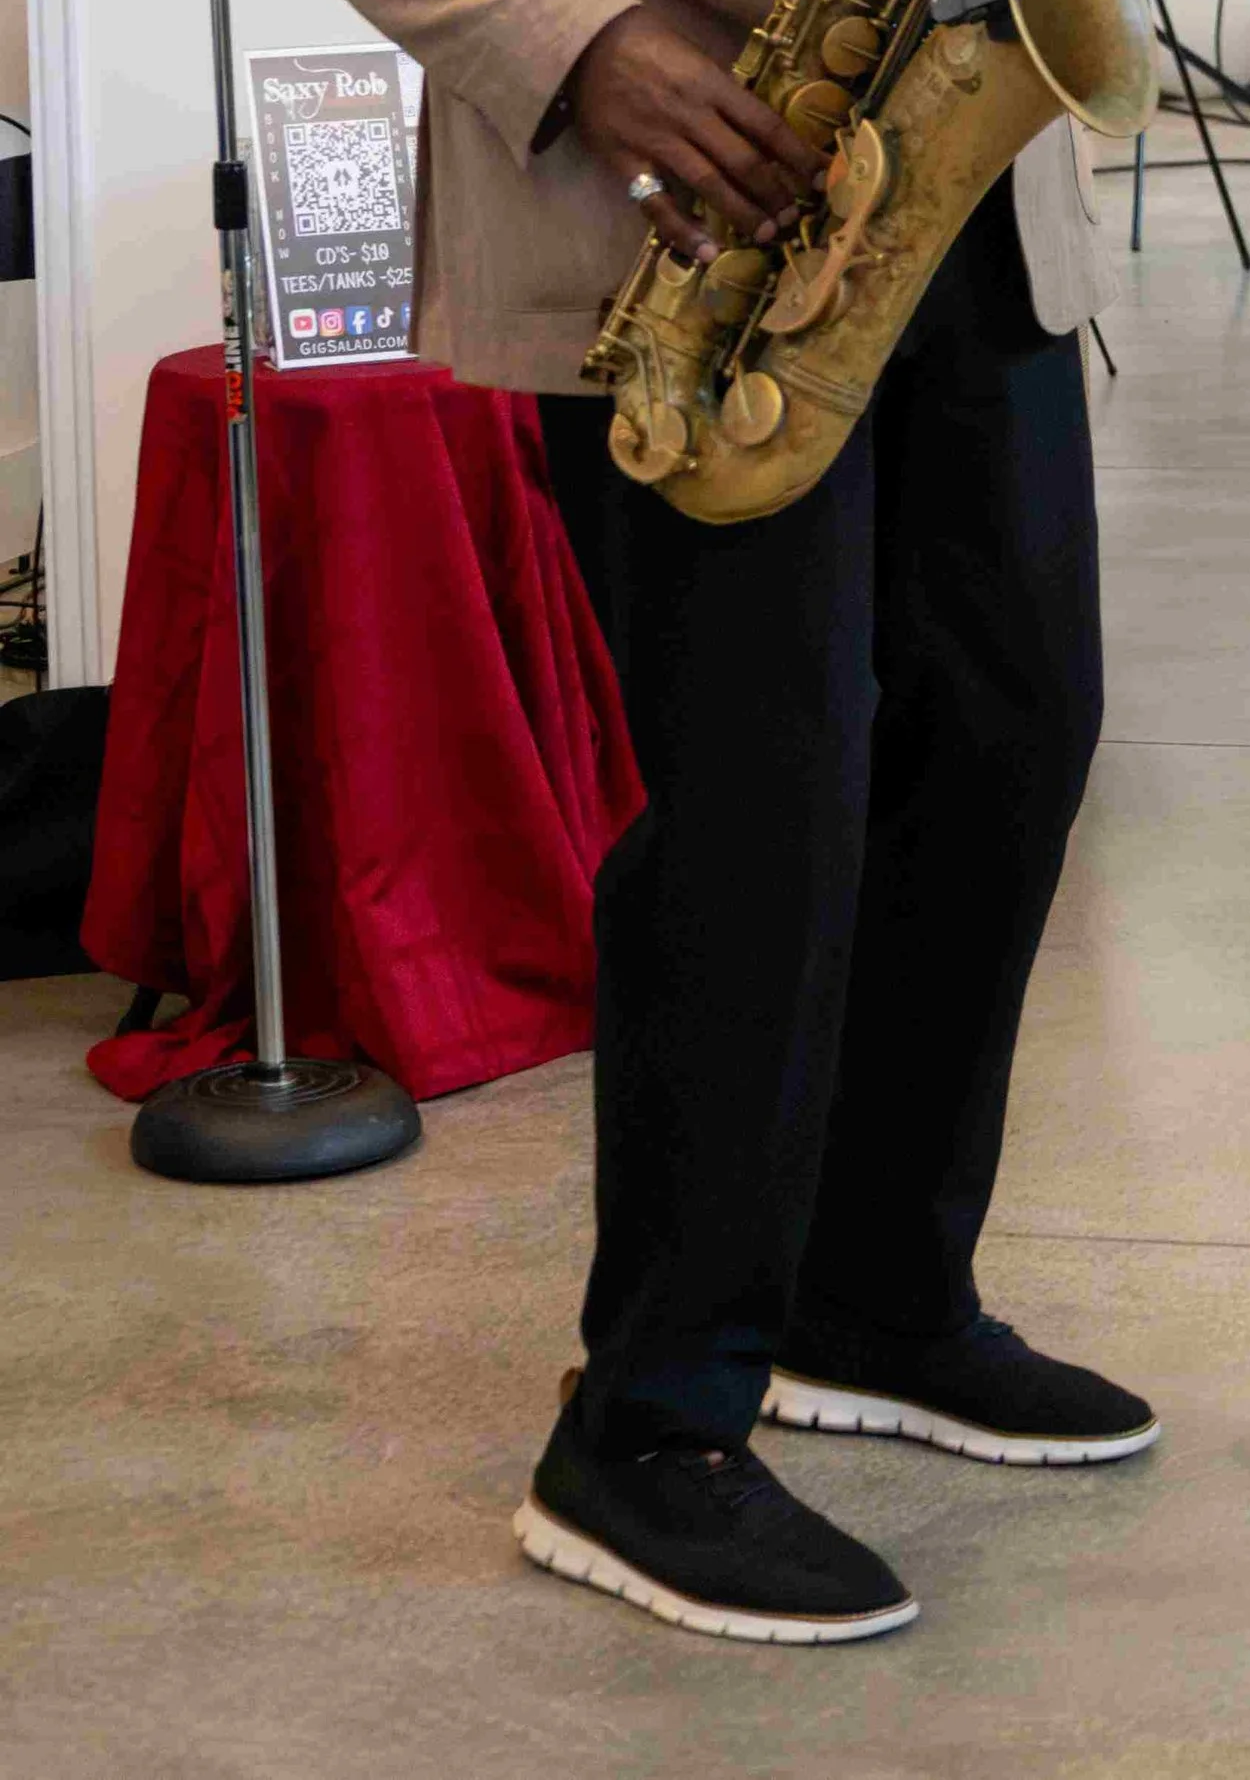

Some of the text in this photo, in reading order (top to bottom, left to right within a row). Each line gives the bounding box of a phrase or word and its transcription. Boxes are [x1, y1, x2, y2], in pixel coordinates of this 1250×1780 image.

[263, 71, 388, 119] Saxy Rob
[361, 241, 389, 265] $10
[280, 270, 376, 294] TEES/TANKS
